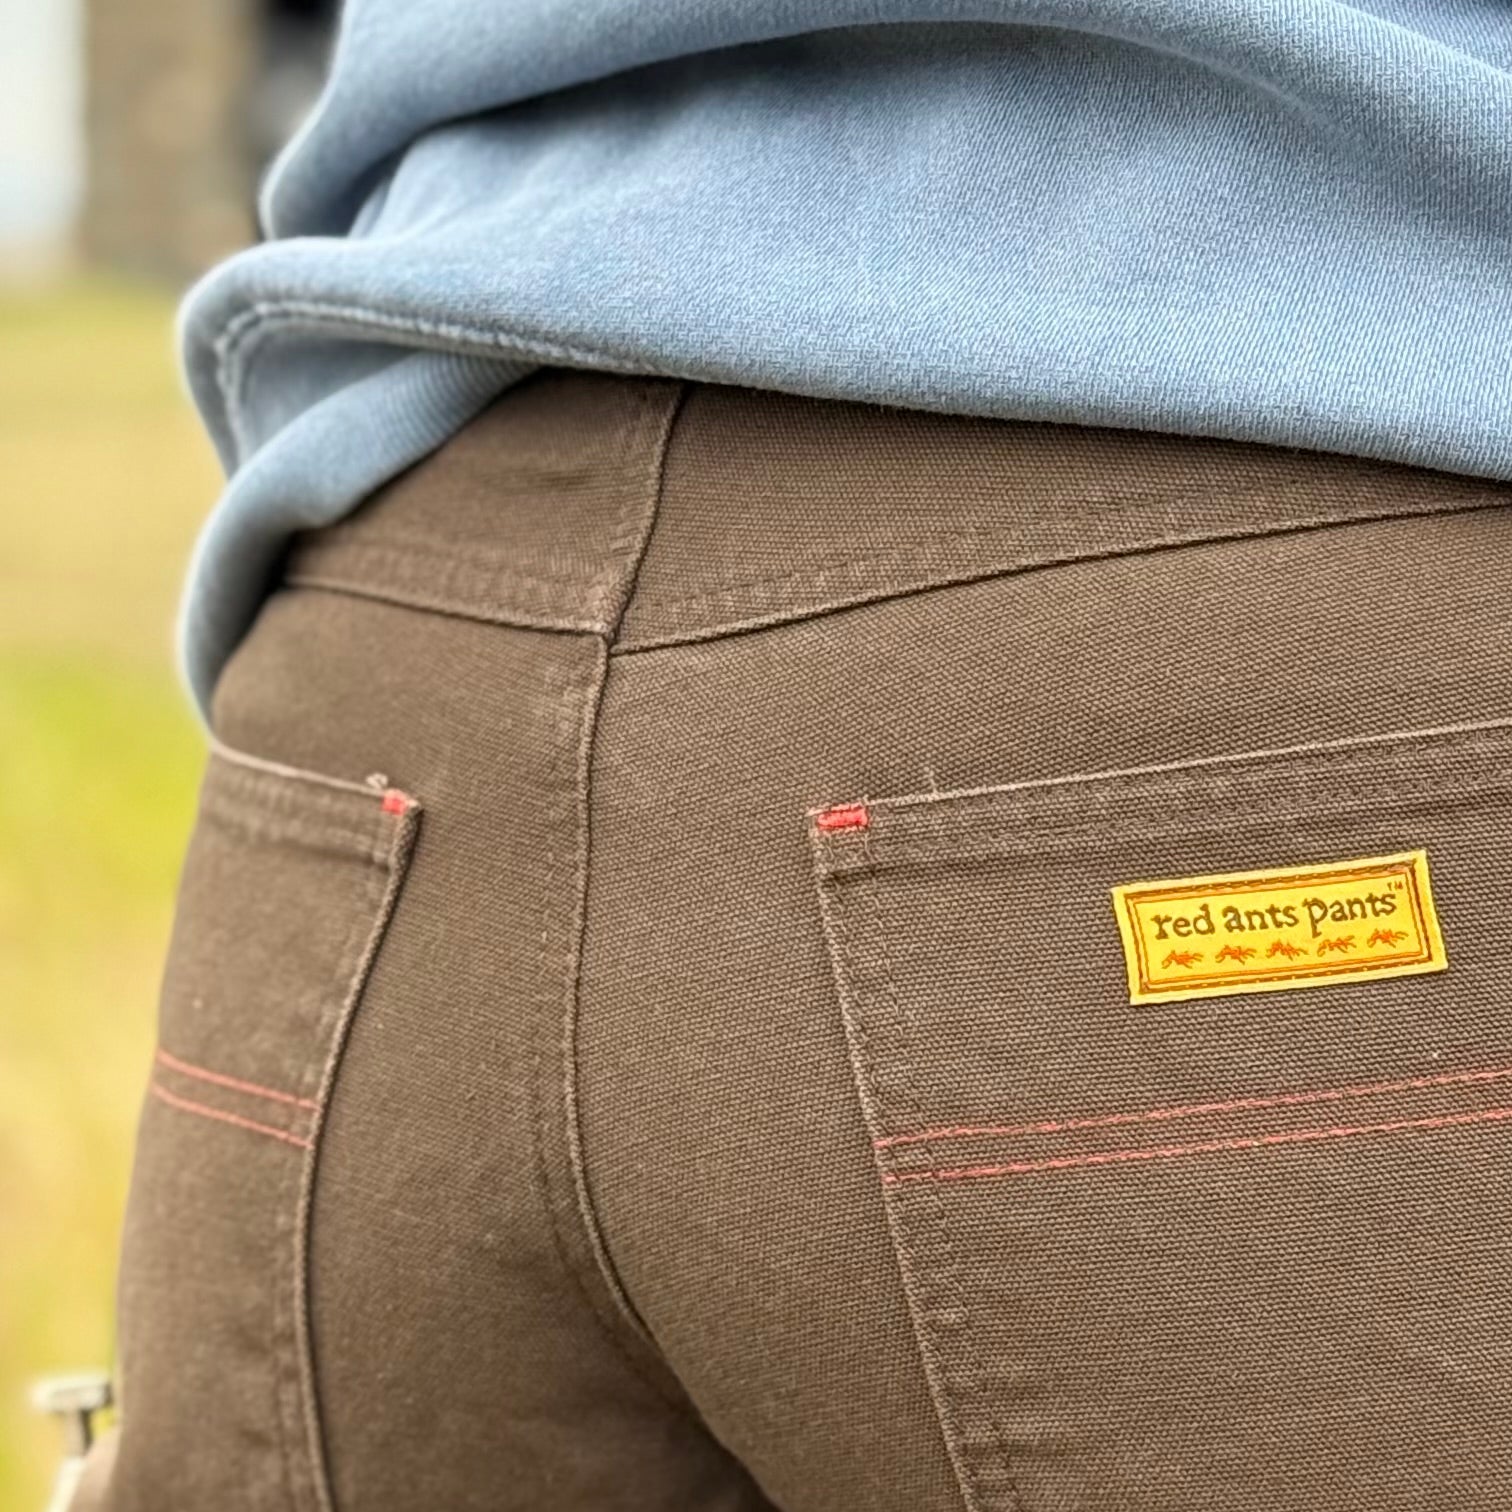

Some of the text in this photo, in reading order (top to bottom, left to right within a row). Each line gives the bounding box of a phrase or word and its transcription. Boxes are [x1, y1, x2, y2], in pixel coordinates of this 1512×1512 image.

[1151, 904, 1216, 940] red
[1223, 903, 1298, 933] ants
[1303, 891, 1396, 938] pants
